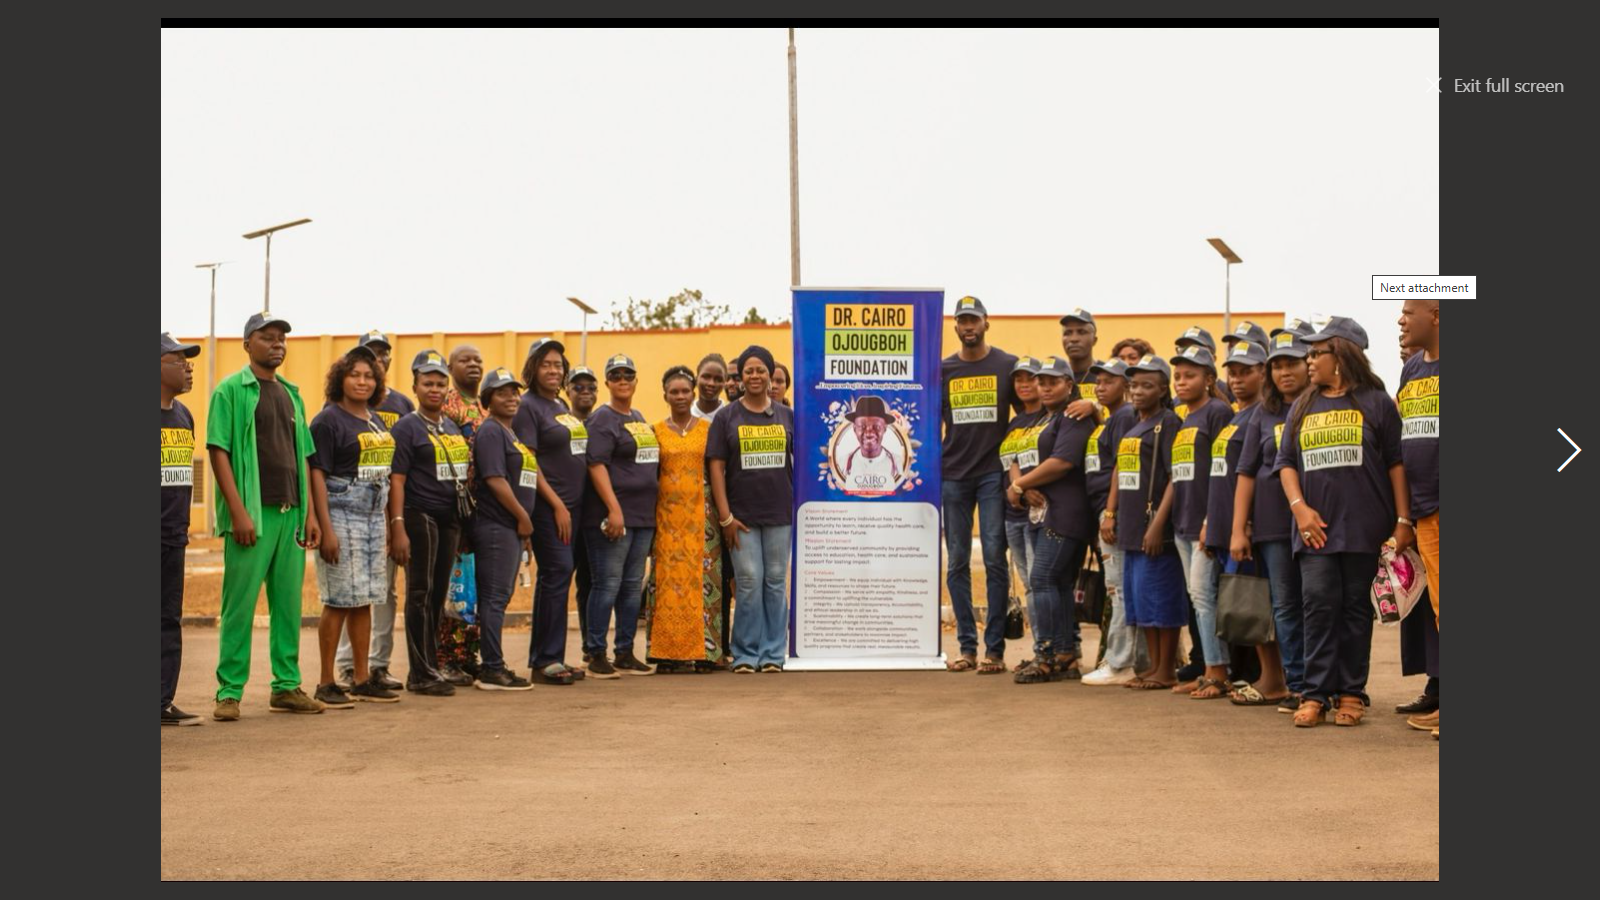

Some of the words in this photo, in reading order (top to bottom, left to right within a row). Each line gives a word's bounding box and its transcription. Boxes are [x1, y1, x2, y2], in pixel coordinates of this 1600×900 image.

[834, 308, 856, 326] DR.
[862, 308, 905, 326] CAIRO
[832, 334, 906, 351] OJOUGBOH
[830, 360, 908, 375] FOUNDATION
[968, 378, 993, 390] CAIRO
[953, 394, 994, 406] OJOUGBOH
[954, 409, 994, 421] FOUNDATION
[1325, 412, 1358, 426] CAIRO
[757, 426, 783, 437] CAIRO
[1304, 428, 1357, 447] OJOUGBOH
[744, 439, 784, 452] OJOUGBOH
[744, 454, 783, 466] FOUNDATION
[1306, 449, 1358, 467] FOUNDATION
[854, 476, 887, 484] CAIRO
